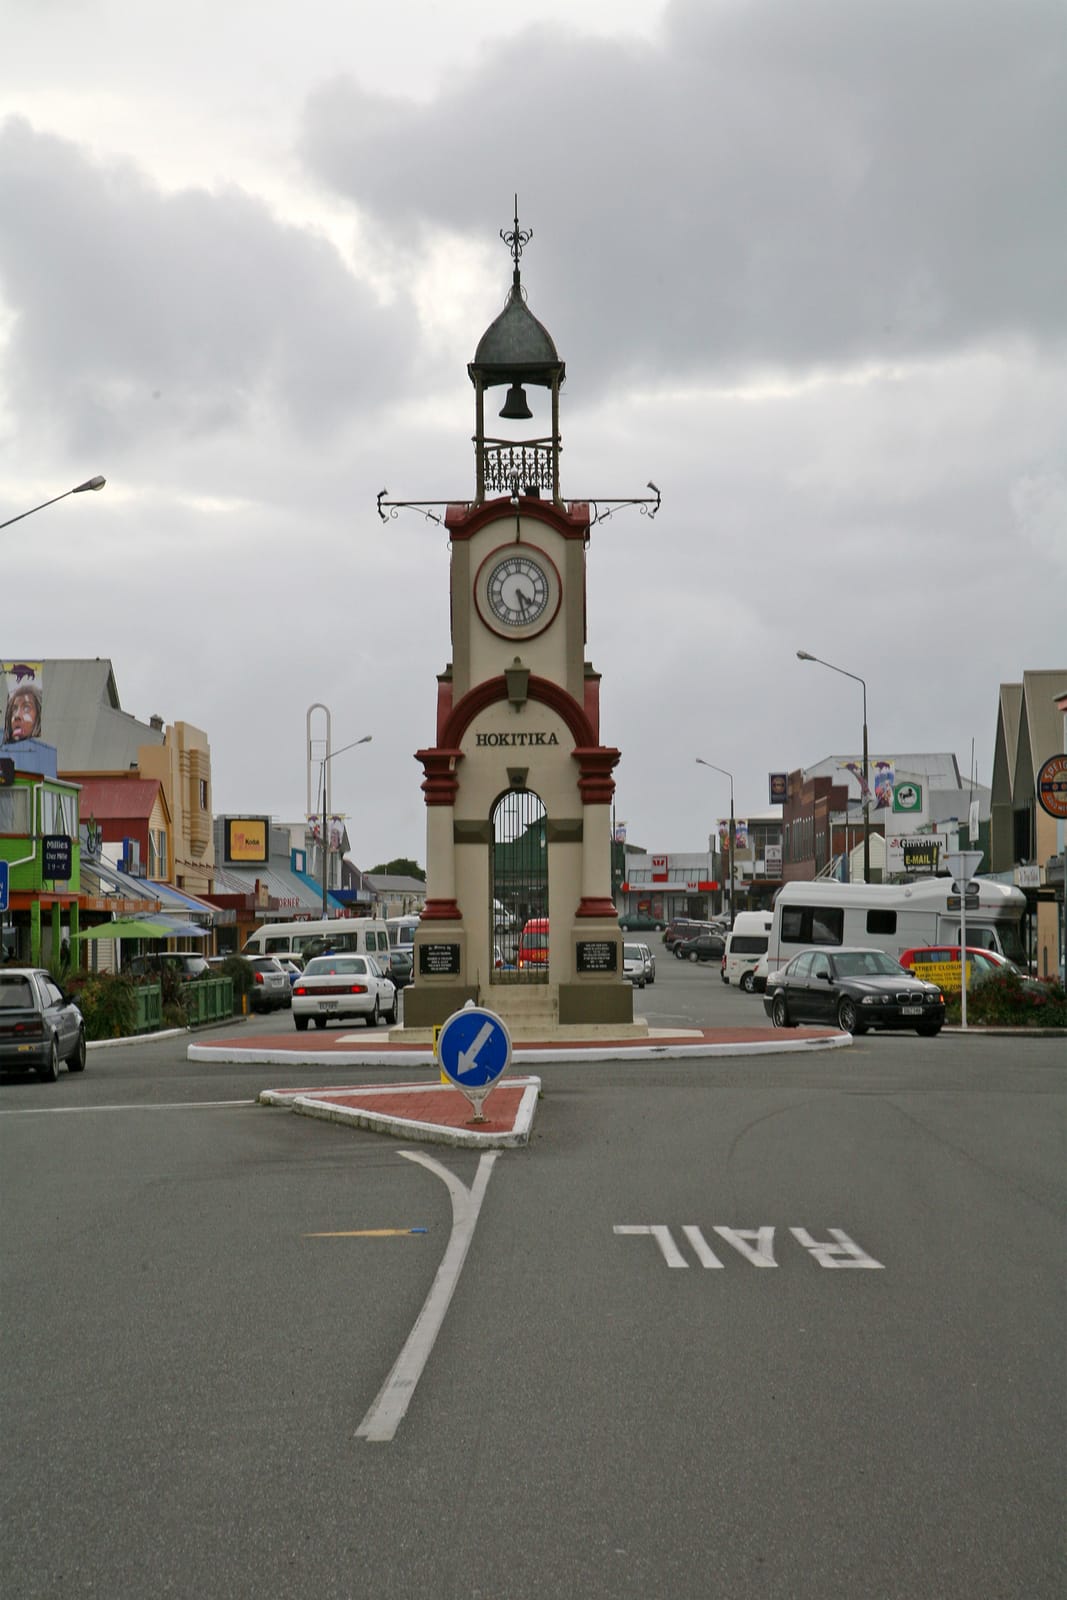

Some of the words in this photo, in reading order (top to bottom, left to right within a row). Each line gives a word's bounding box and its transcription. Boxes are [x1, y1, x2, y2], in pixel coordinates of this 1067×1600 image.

[476, 732, 559, 747] HOKITIKA
[46, 840, 69, 849] Millies
[905, 854, 931, 865] E-MAIL
[279, 896, 300, 908] ORNER
[938, 963, 963, 971] CLOSUR
[613, 1225, 885, 1268] RAIL
